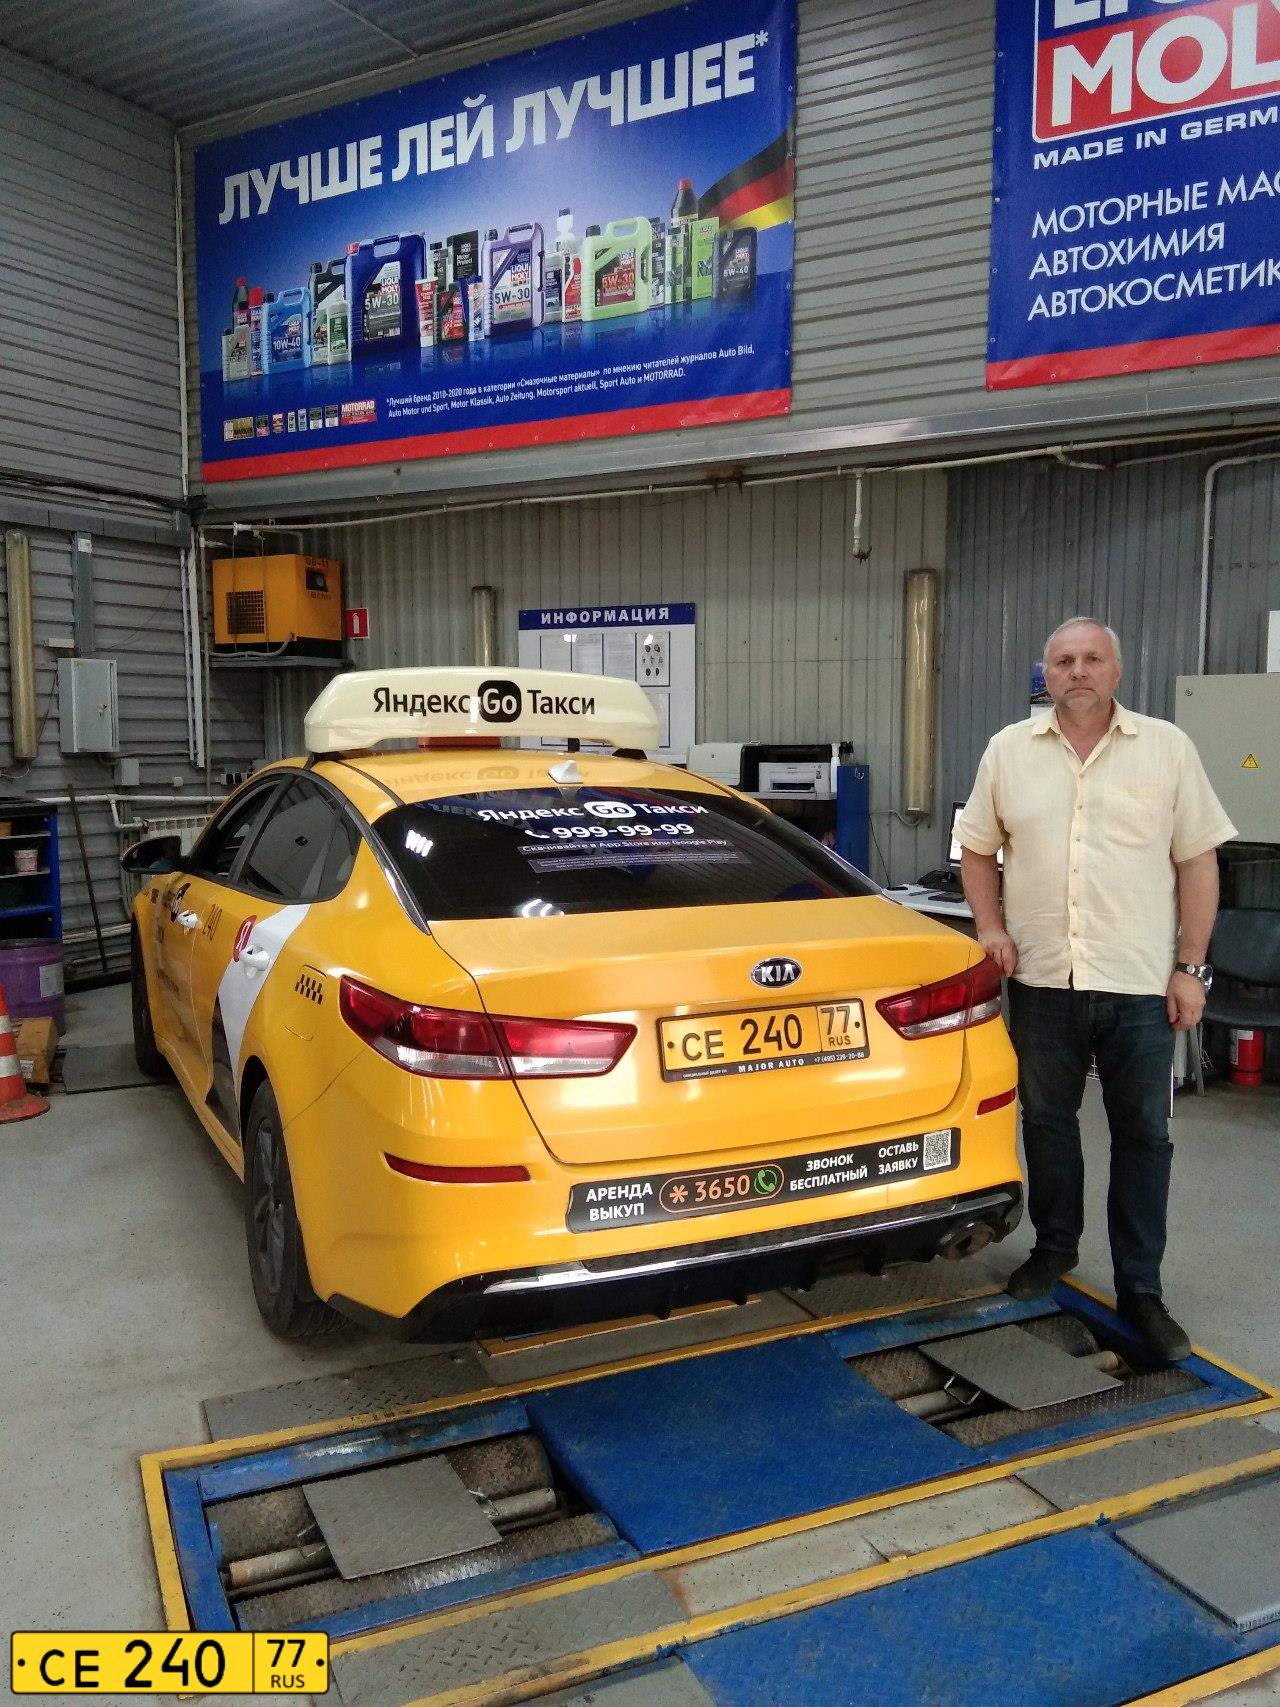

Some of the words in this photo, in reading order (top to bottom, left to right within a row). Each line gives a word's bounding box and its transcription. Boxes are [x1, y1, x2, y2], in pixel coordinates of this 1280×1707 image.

[1052, 0, 1280, 127] MOL
[218, 135, 383, 225] ЛУЧШЕ
[392, 93, 495, 182] ЛЕЙ
[1034, 136, 1124, 170] MADE
[1136, 128, 1167, 150] IN
[1031, 181, 1209, 239] МОТОРНЫЕ
[1028, 222, 1226, 280] АВТОХИМИЯ
[364, 293, 399, 310] 5W-30
[494, 287, 530, 304] 5W-30
[273, 336, 301, 351] 10W-40
[413, 393, 432, 404] бренд
[463, 387, 477, 396] года
[483, 381, 516, 394] категории
[602, 367, 612, 376] по
[612, 362, 642, 374] мнению
[642, 355, 680, 370] читателей
[680, 350, 718, 366] журналов
[718, 348, 737, 358] Auto
[737, 343, 755, 356] Bild,
[388, 408, 402, 419] Auto
[402, 406, 421, 417] Motor
[421, 404, 432, 414] und
[432, 403, 450, 414] Sport,
[450, 399, 469, 410] Motor
[469, 397, 495, 407] Klassik,
[495, 393, 510, 404] Auto
[536, 384, 573, 398] Motorsport
[573, 380, 598, 393] aktuell,
[599, 377, 619, 390] Sport
[620, 375, 637, 386] Auto
[643, 367, 686, 383] MOTORRAD.
[341, 400, 375, 413] MOTORRAD
[541, 607, 670, 625] ИНФОРМАЦИЯ
[373, 687, 471, 717] Яндекс
[481, 687, 518, 715] Go
[527, 689, 596, 716] Такси
[478, 806, 585, 822] Яндекс
[633, 803, 710, 815] Такси
[552, 823, 695, 840] 999-99-99
[522, 842, 586, 853] Скачивайте
[599, 841, 621, 850] App
[622, 840, 650, 848] Store
[672, 838, 706, 847] Google
[707, 838, 728, 847] Play
[760, 964, 796, 983] KIA
[820, 1005, 851, 1035] 77
[681, 1029, 725, 1061] СЕ
[739, 1013, 804, 1056] 240
[828, 1036, 851, 1047] RUS
[738, 1061, 775, 1073] MAJOR
[778, 1058, 805, 1068] AUTO
[878, 1141, 920, 1159] ОСТАВЬ
[805, 1153, 855, 1172] ЗВОНОК
[878, 1156, 920, 1176] ЗАЯВКУ
[694, 1174, 751, 1202] 3650
[789, 1165, 868, 1192] БЕСПЛАТНЫЙ
[585, 1182, 653, 1203] АРЕНДА
[589, 1202, 645, 1222] ВЫКУП
